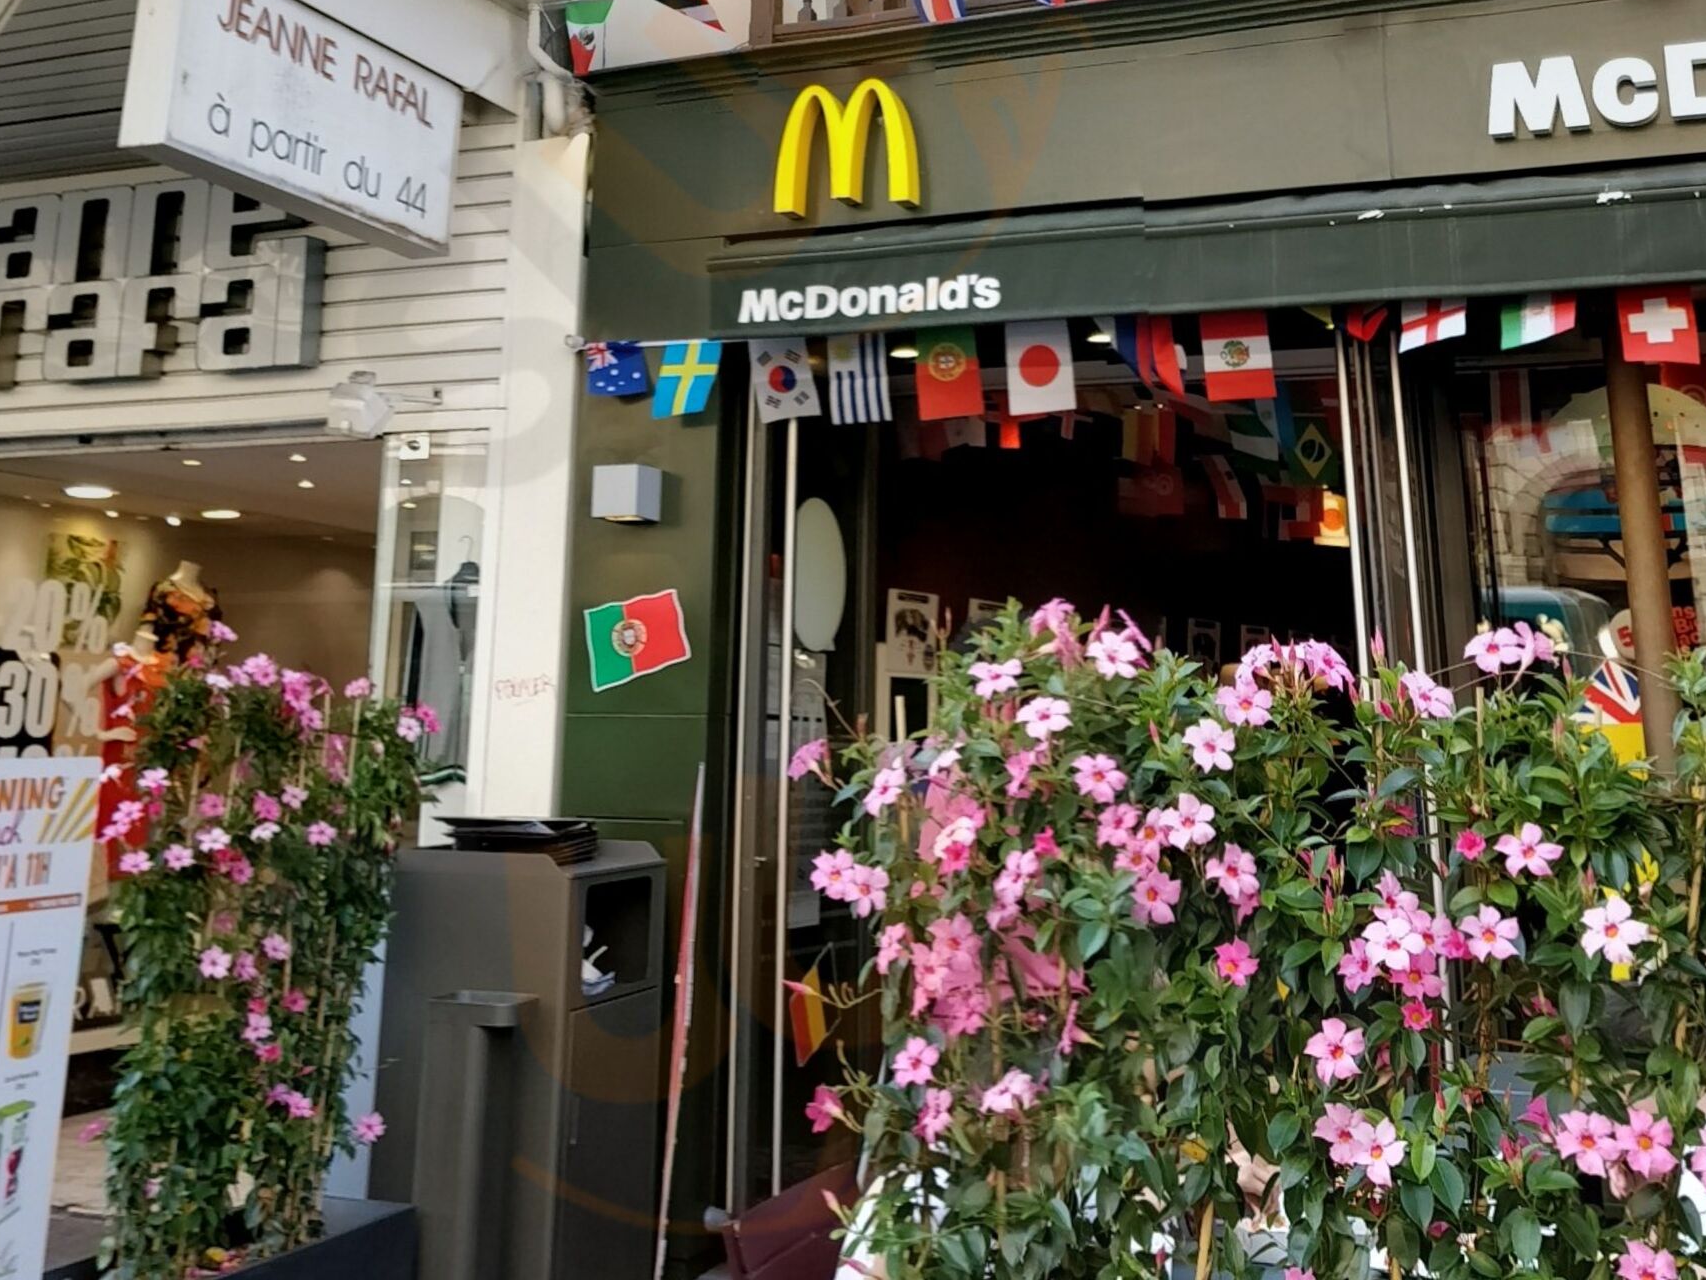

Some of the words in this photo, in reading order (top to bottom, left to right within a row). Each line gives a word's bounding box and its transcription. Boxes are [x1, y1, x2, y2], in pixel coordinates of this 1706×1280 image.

[354, 51, 435, 129] RAFAL
[209, 93, 231, 136] à
[248, 117, 327, 177] partir
[344, 154, 382, 199] du
[396, 176, 429, 218] 44
[738, 273, 1001, 324] McDonald's
[26, 851, 52, 886] 11H
